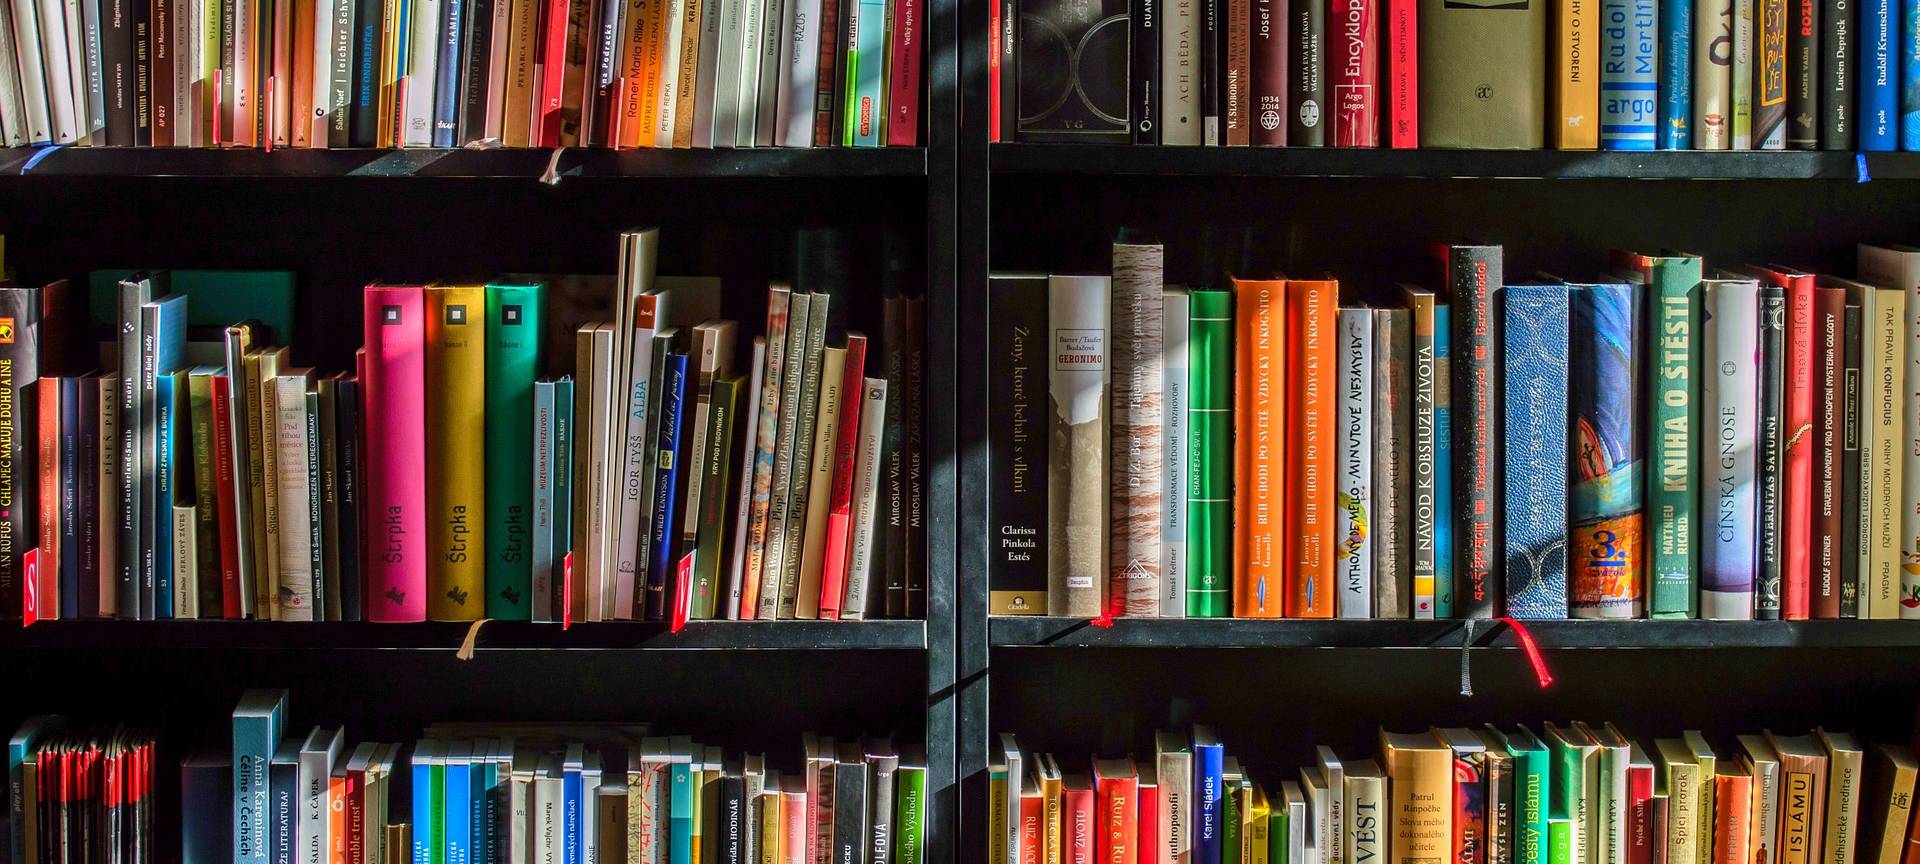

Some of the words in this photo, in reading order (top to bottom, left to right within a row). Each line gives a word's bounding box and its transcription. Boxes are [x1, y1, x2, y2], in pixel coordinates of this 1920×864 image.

[448, 9, 458, 44] KAMIL
[632, 18, 644, 43] Rilke
[1259, 8, 1270, 38] Josef
[337, 30, 348, 72] leichter
[630, 46, 642, 79] Maria
[1836, 60, 1845, 91] Lucien
[1877, 52, 1886, 86] Rudolf
[627, 81, 640, 118] Rainer
[1179, 74, 1188, 102] ACH
[1606, 99, 1654, 122] argo
[1259, 290, 1272, 350] INKOGNITO
[1308, 290, 1319, 350] INKOGNITO
[1884, 306, 1894, 326] TAK
[1660, 296, 1689, 378] ŠTĚSTÍ
[1884, 329, 1894, 364] PRAVIL
[1058, 354, 1102, 364] GERONIMO
[1416, 345, 1432, 402] ŽIVOTA
[633, 380, 647, 420] ALBA
[1664, 390, 1688, 406] O
[1882, 366, 1892, 426] KONFUCIUS
[1258, 444, 1269, 460] PO
[1307, 444, 1318, 460] PO
[1418, 406, 1432, 475] OBSLUZE
[1663, 416, 1688, 492] KNIHA
[1722, 407, 1736, 469] GNOSE
[1882, 438, 1891, 467] KNIHY
[124, 429, 132, 503] Sutherland-Smith
[890, 451, 900, 478] VÁLEK
[910, 452, 920, 479] VÁLEK
[1390, 450, 1400, 491] MELLO
[628, 470, 640, 501] IGOR
[657, 474, 668, 512] TENNYSON
[1170, 468, 1178, 528] TRANSFORMACE
[1419, 478, 1431, 488] K
[124, 506, 132, 530] James
[772, 494, 785, 520] Plop!
[791, 494, 804, 520] Plop!
[890, 480, 900, 526] MIROSLAV
[910, 481, 920, 528] MIROSLAV
[1350, 487, 1361, 523] MELLO
[1390, 495, 1400, 509] DE
[1716, 476, 1735, 542] ČÍNSKÁ
[384, 506, 406, 563] Štrpka
[446, 505, 472, 562] Štrpka
[502, 506, 525, 562] Štrpka
[656, 514, 665, 542] ALFRED
[1002, 525, 1036, 535] Clarissa
[1350, 524, 1360, 536] DE
[1416, 494, 1432, 550] NÁVOD
[1664, 505, 1674, 554] MATTHIEU
[1677, 517, 1688, 554] RICARD
[768, 526, 781, 571] Wernisch
[786, 526, 799, 570] Wernisch
[1002, 538, 1036, 548] Pinkola
[1008, 551, 1030, 561] Estés
[1590, 530, 1626, 558] 3.
[1822, 535, 1832, 566] STEINER
[1169, 548, 1178, 576] Keltner
[1348, 538, 1362, 593] ANTHONY
[767, 572, 778, 588] Ivan
[784, 572, 794, 588] Ivan
[1168, 578, 1177, 600] Tomáš
[1822, 568, 1832, 596] RUDOLF
[1880, 562, 1890, 600] PRAGMA
[254, 755, 264, 786] Anna
[1202, 776, 1214, 810] Sládek
[1524, 774, 1540, 824] islámu
[1677, 774, 1688, 812] prorok
[1840, 768, 1852, 812] meditace
[280, 791, 288, 852] LITERATURA?
[1168, 793, 1180, 860] anthroposofií
[1204, 814, 1213, 839] Karel
[1788, 780, 1806, 852] ISLÁMU
